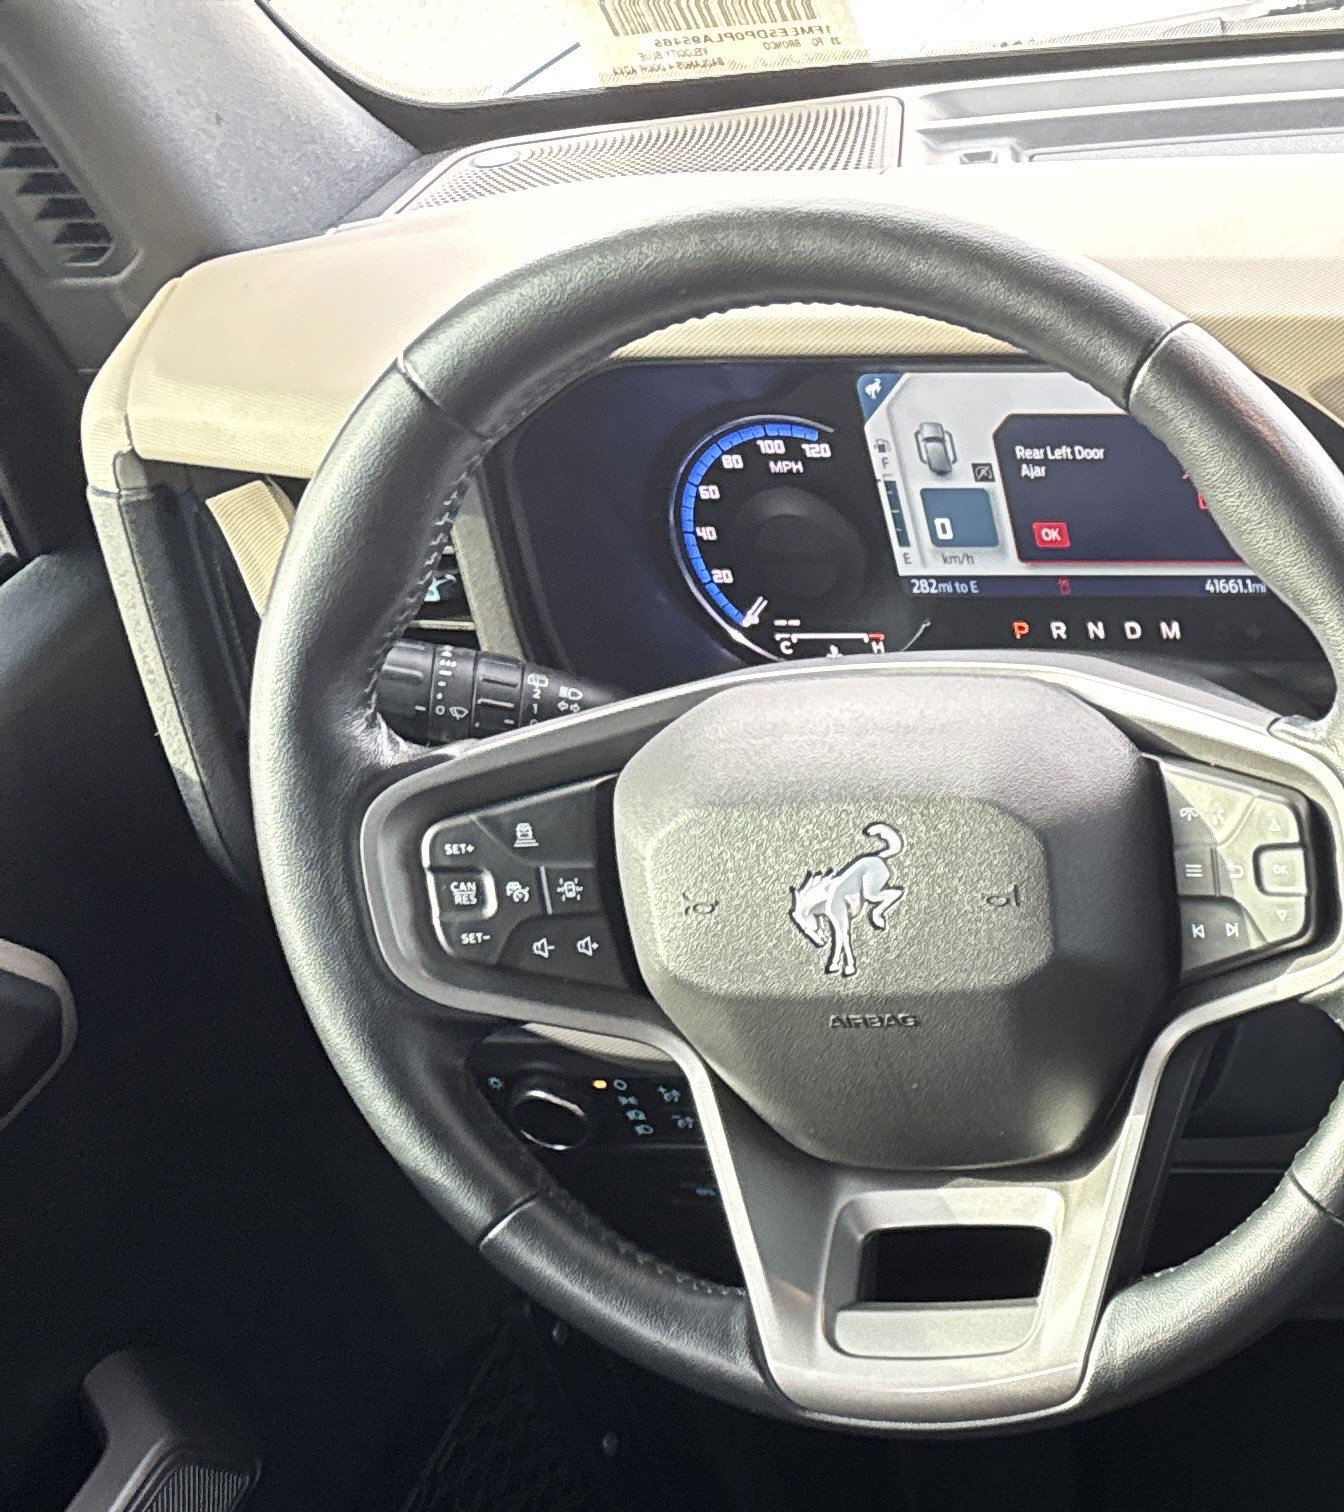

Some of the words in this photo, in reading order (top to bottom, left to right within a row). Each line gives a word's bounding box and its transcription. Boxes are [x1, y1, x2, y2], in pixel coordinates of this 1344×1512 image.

[756, 440, 785, 454] 100
[802, 444, 831, 458] 120
[1015, 446, 1044, 460] Rear
[1047, 445, 1073, 460] Left
[1074, 445, 1105, 460] Door
[722, 455, 743, 469] 80
[769, 461, 803, 474] MPH
[882, 458, 889, 469] F
[1020, 463, 1046, 479] Ajar
[699, 485, 720, 500] 60
[696, 527, 717, 541] 40
[934, 517, 953, 540] 0
[1041, 528, 1062, 541] OK
[903, 553, 912, 564] E
[942, 552, 975, 565] km/h
[711, 569, 733, 583] 20
[954, 580, 968, 593] to
[970, 581, 979, 593] E
[1013, 621, 1029, 639] P
[1050, 621, 1068, 639] R
[1087, 621, 1105, 639] N
[1124, 621, 1142, 639] D
[1160, 621, 1181, 639] M
[780, 641, 793, 655] C
[872, 642, 885, 654] H
[531, 688, 542, 699] 2
[532, 703, 539, 715] 1
[1272, 864, 1289, 875] OK
[450, 881, 476, 892] CAN
[454, 894, 477, 905] RES
[828, 1012, 921, 1030] AIRBAG
